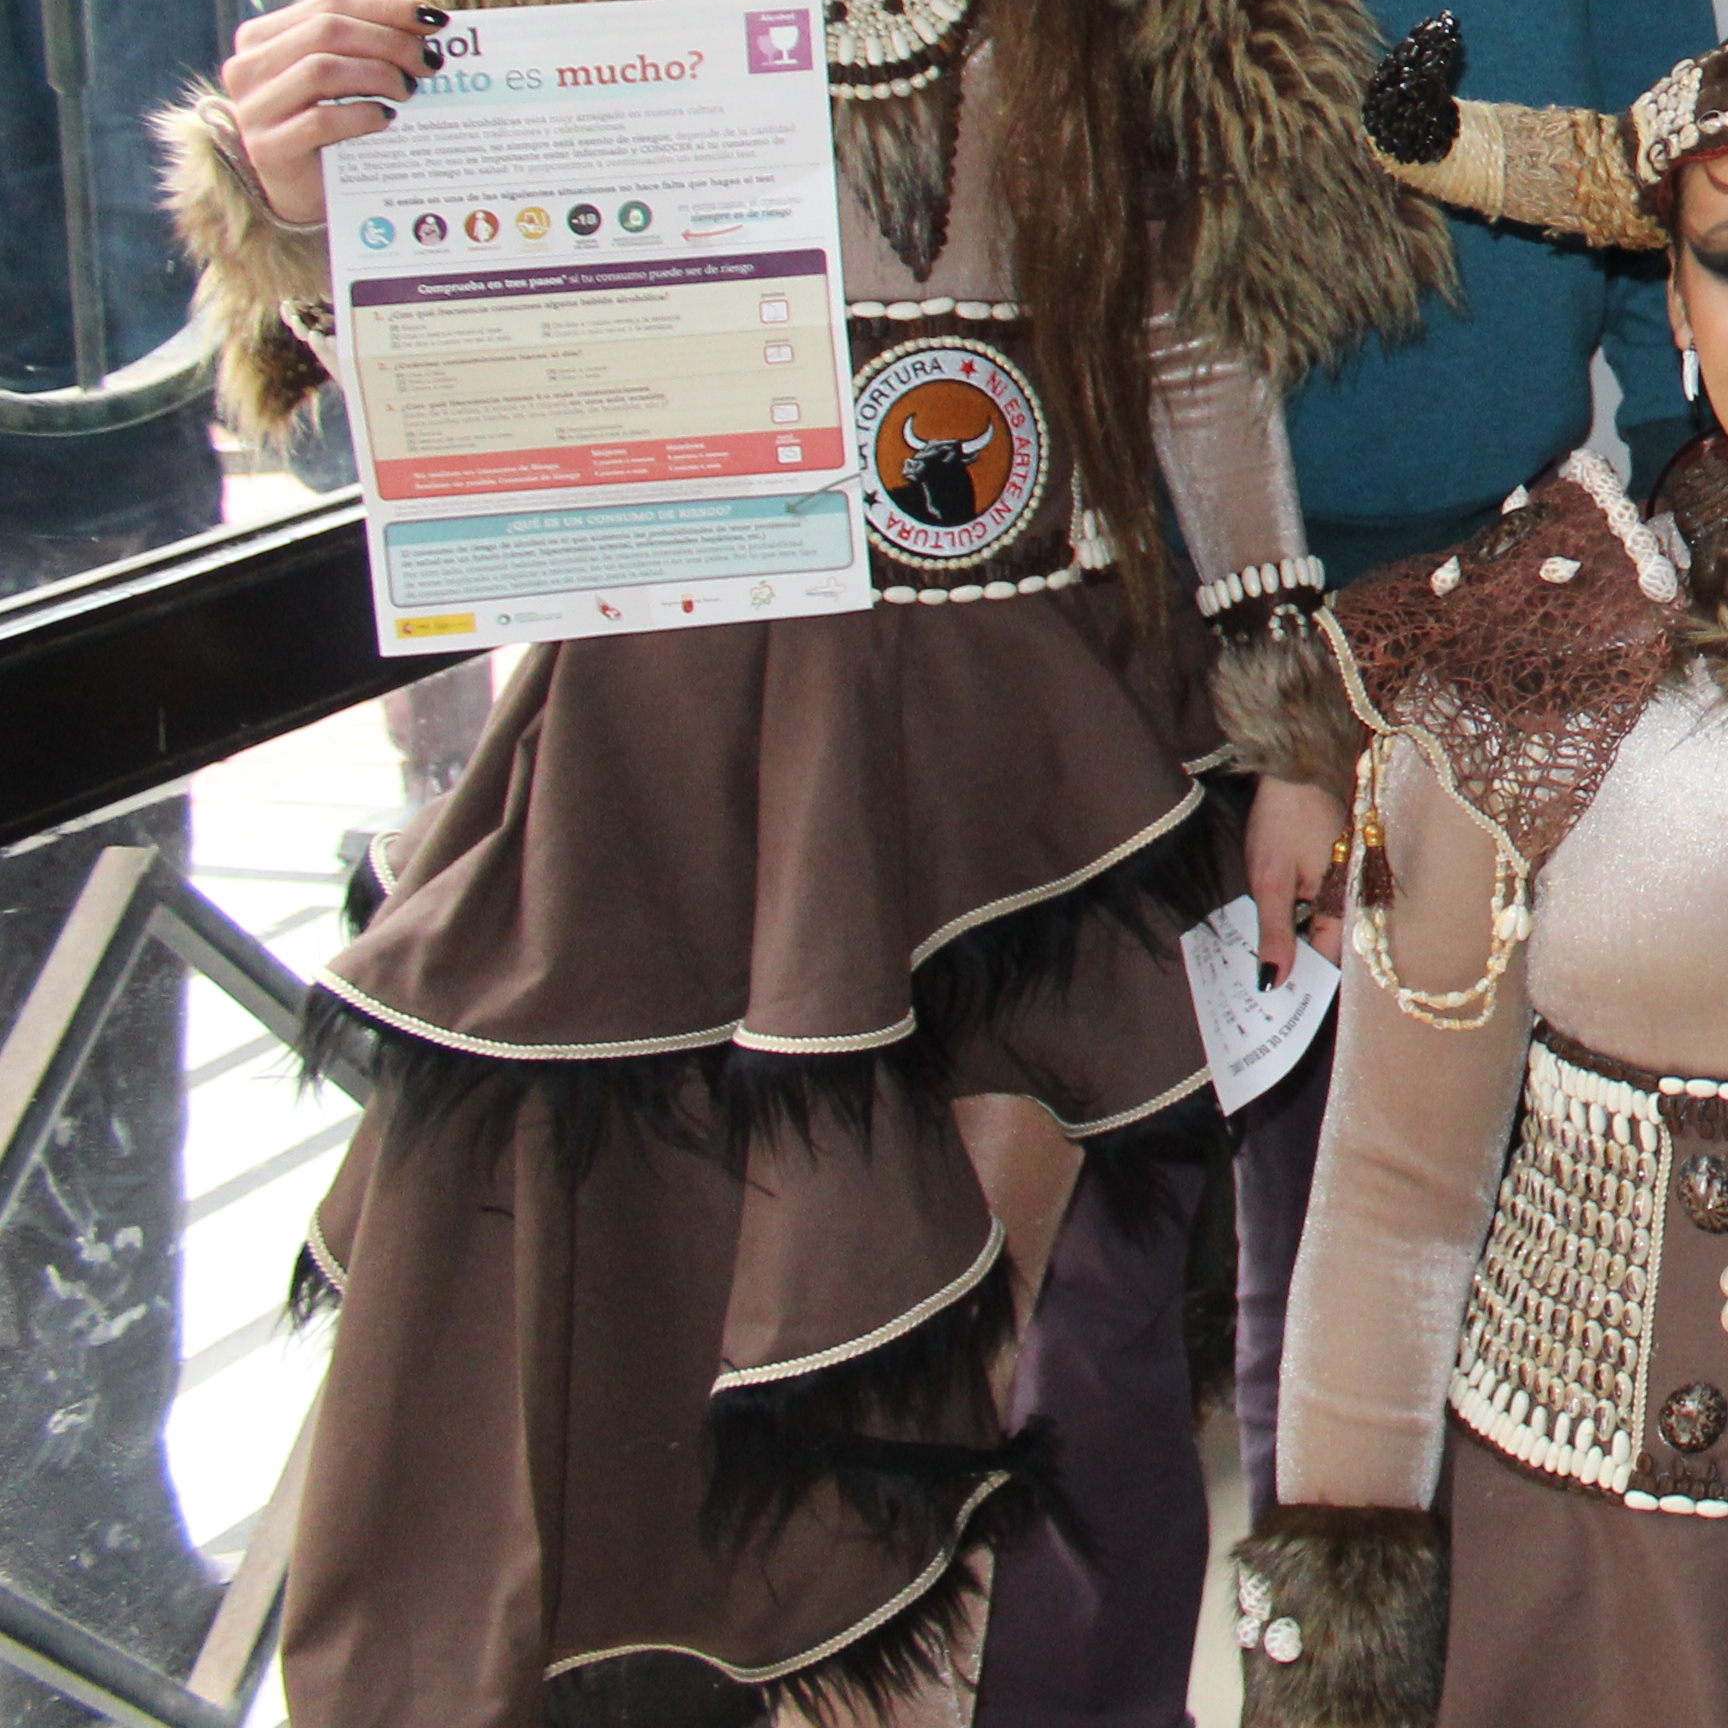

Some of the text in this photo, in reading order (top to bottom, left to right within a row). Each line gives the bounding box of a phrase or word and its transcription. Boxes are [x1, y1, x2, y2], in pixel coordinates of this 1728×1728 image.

[505, 69, 543, 90] es
[556, 49, 704, 87] mucho?
[572, 212, 598, 228] -18
[416, 278, 485, 296] Comprueba
[486, 279, 502, 289] en
[504, 275, 527, 288] tres
[569, 272, 578, 283] si
[580, 271, 593, 282] tu
[595, 269, 646, 282] consumo
[648, 265, 683, 280] puede
[685, 266, 701, 275] ser
[703, 262, 718, 274] de
[720, 260, 753, 275] riesgo
[857, 357, 945, 432] TORTURA
[1004, 398, 1026, 428] ES
[1006, 436, 1031, 498] ARTE
[886, 511, 986, 549] CULTURA
[988, 500, 1013, 525] NI
